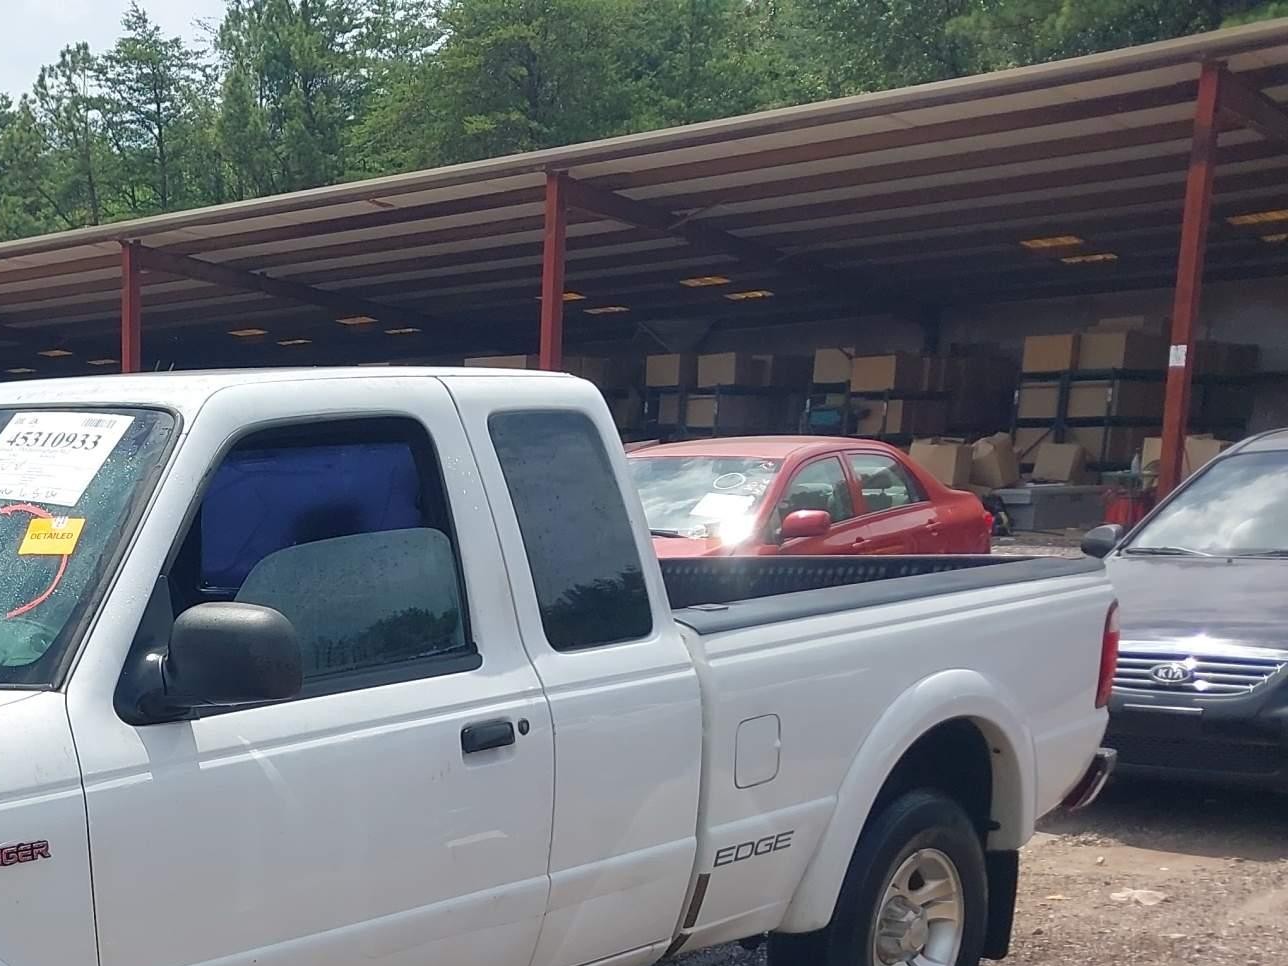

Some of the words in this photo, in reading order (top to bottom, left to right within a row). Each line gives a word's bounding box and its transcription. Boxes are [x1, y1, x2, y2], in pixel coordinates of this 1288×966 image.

[7, 431, 102, 450] 45310933
[30, 532, 74, 540] DETAILED
[1158, 668, 1184, 679] KIA
[713, 830, 794, 868] EDGE
